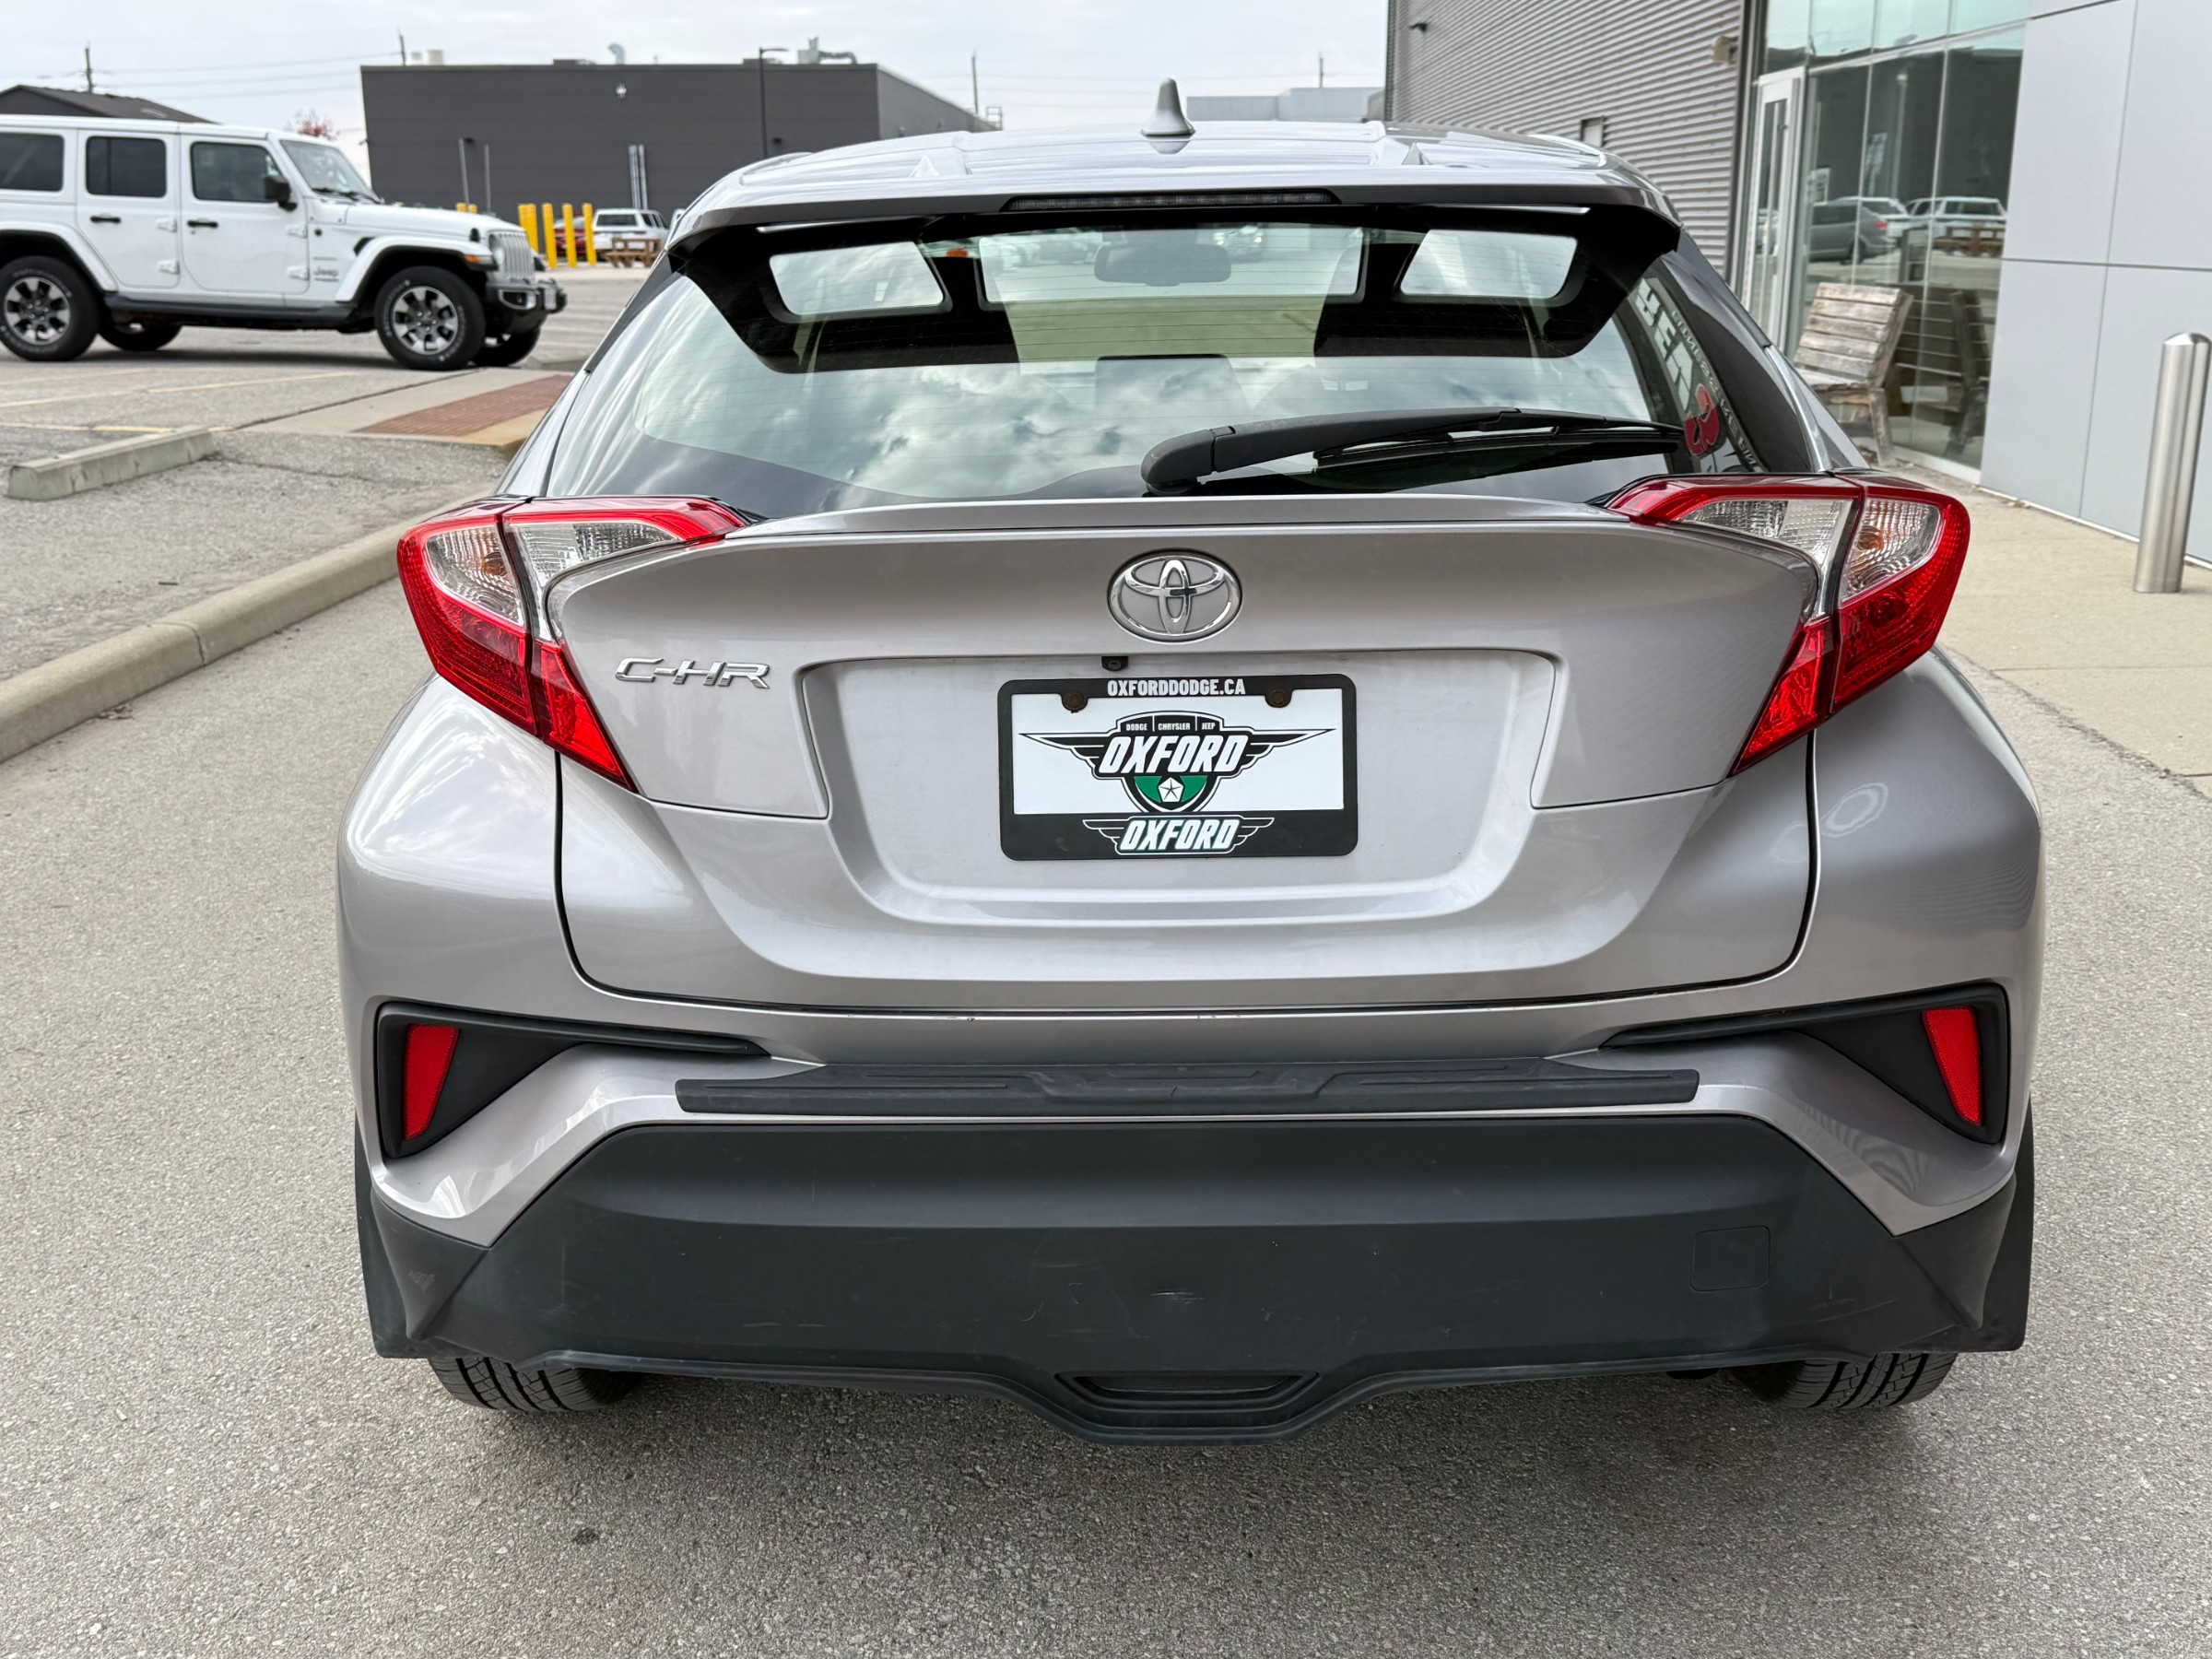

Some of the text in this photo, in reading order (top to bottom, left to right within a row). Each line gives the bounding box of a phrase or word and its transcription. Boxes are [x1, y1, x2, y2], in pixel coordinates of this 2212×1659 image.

[615, 658, 770, 689] C-HR
[1107, 678, 1246, 696] OXFORDDODGE.CA
[1158, 723, 1191, 731] CHRYSLER
[1201, 722, 1216, 730] JEEP
[1099, 735, 1249, 774] OXFORD
[1120, 819, 1240, 851] OXFORD
